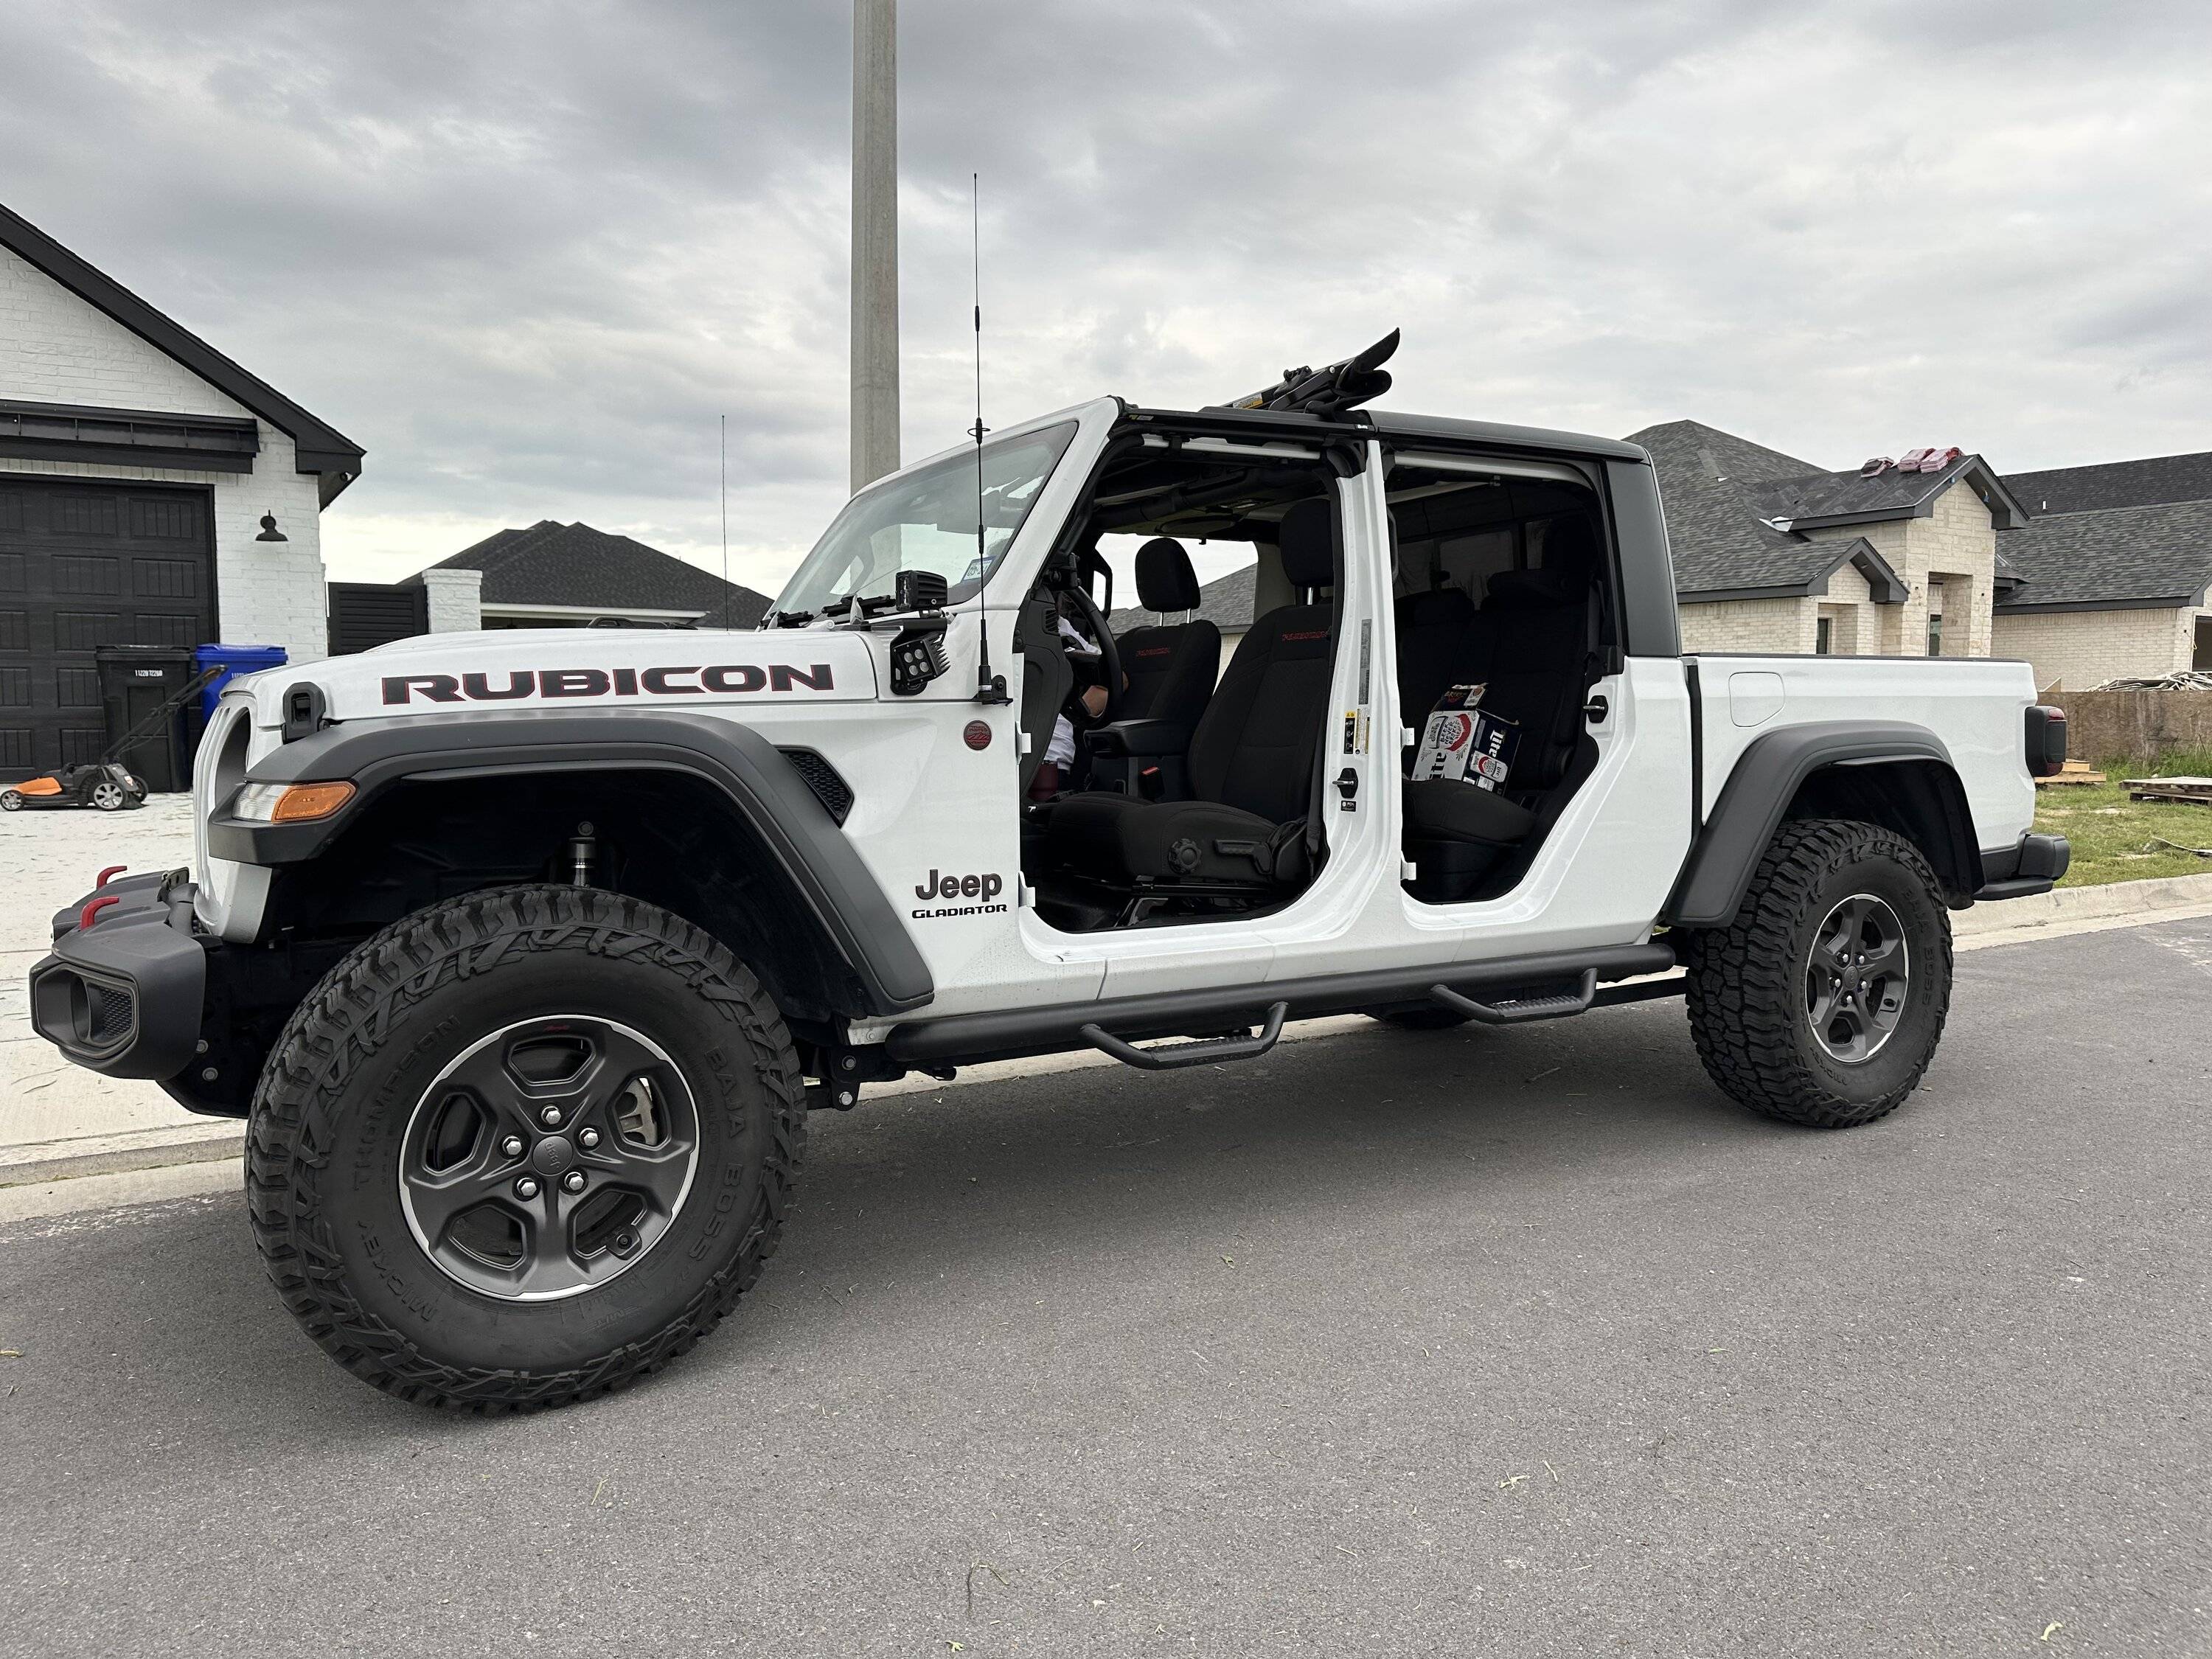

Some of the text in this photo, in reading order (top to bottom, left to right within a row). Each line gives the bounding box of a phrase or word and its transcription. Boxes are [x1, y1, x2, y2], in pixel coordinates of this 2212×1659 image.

[381, 664, 834, 706] RUBICON
[914, 869, 1003, 902] Jeep
[911, 904, 1008, 919] GLADIATOR
[689, 1046, 747, 1262] BAJA BOSS
